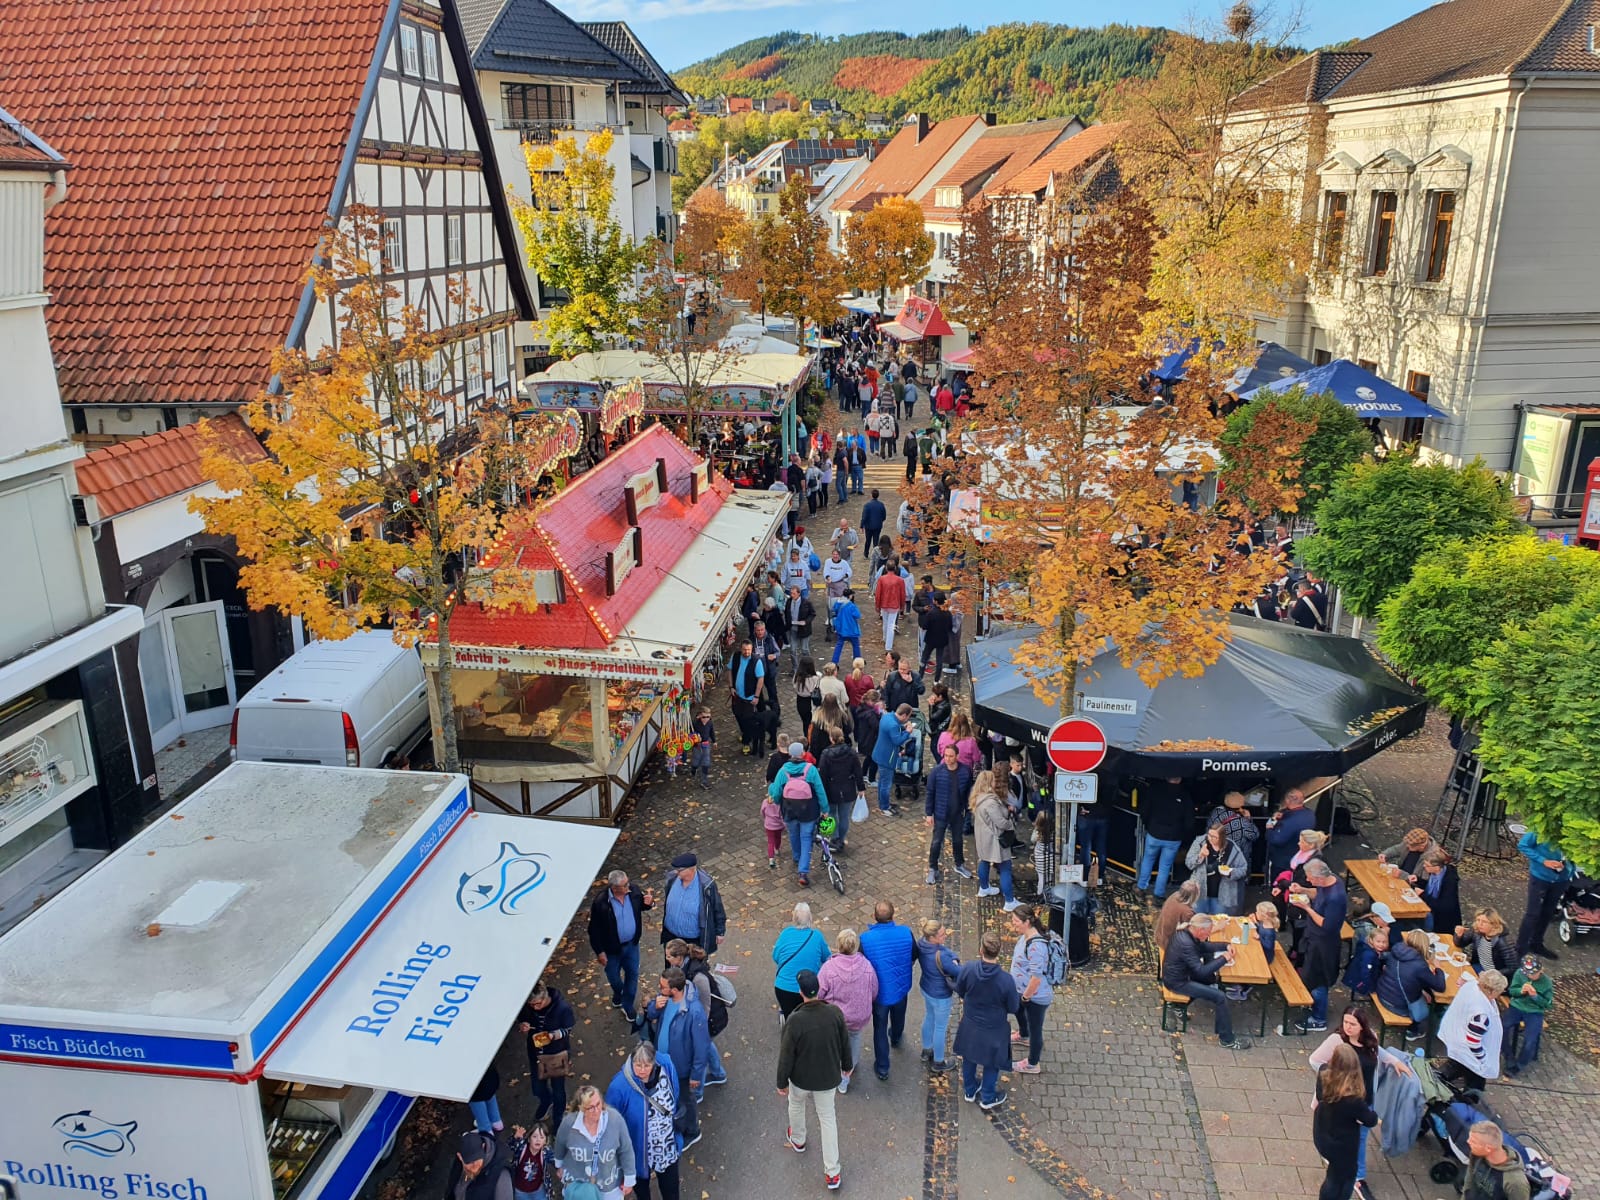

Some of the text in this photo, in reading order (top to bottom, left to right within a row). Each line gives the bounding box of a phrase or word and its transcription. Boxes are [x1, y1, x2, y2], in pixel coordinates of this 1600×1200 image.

[1086, 699, 1134, 712] Paulinenstr.
[1202, 758, 1271, 772] Pommes.
[1069, 791, 1082, 799] frei
[345, 941, 451, 1037] Rolling
[404, 973, 482, 1046] Fisch
[10, 1034, 146, 1058] Fisch Büdchen
[3, 1160, 208, 1200] Rolling Fisch
